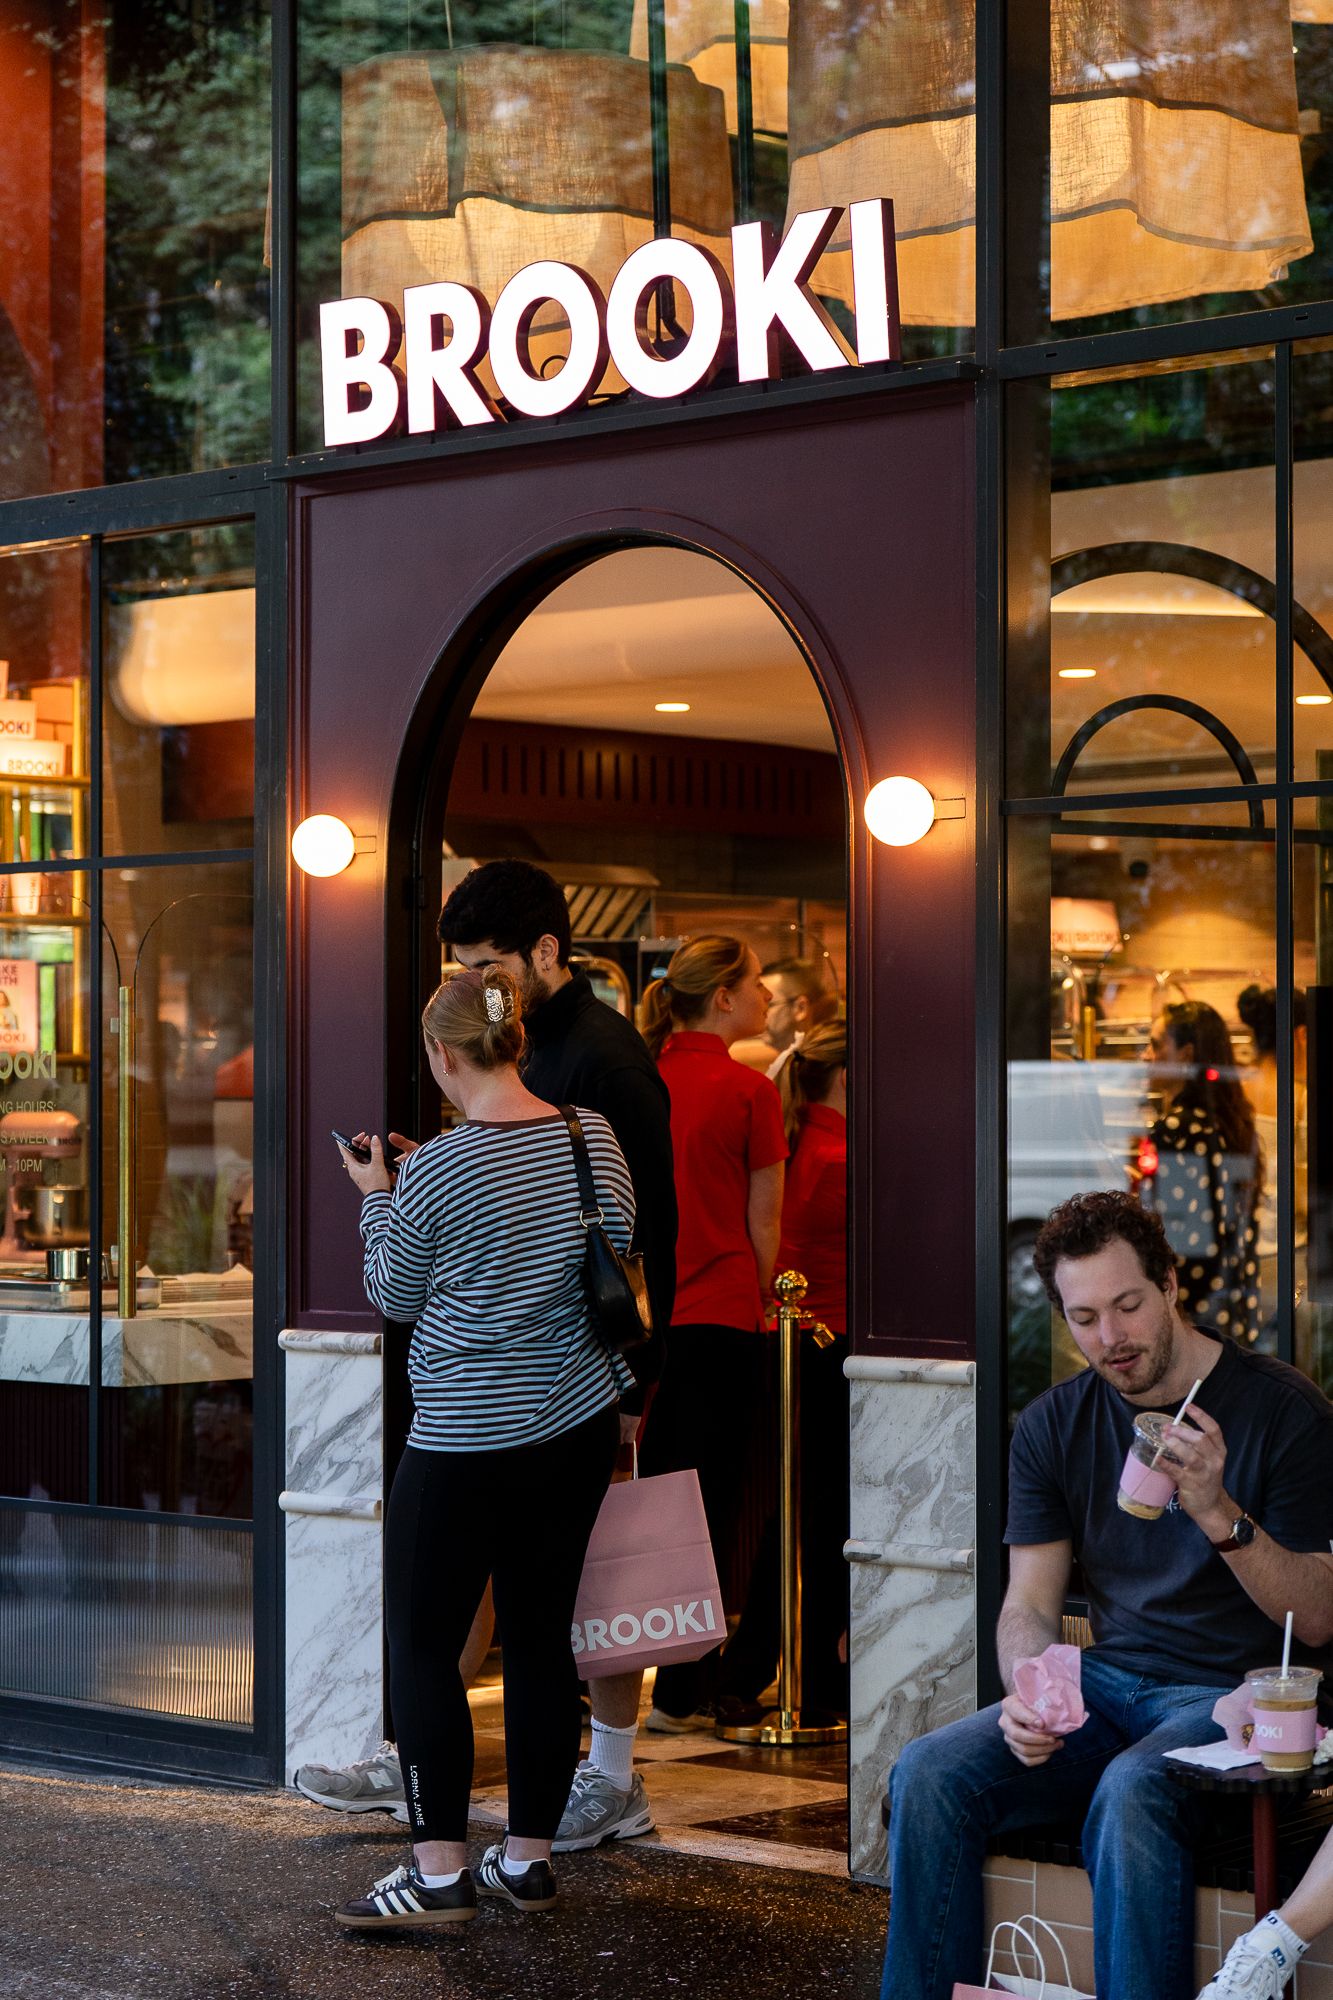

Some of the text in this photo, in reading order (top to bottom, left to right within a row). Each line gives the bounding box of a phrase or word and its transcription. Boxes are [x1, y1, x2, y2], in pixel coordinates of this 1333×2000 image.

[319, 198, 894, 447] BROOKI
[8, 759, 59, 775] BROOKI
[0, 965, 17, 975] KE
[16, 1101, 57, 1113] HOURS:
[19, 1131, 49, 1144] WEEK
[16, 1159, 42, 1172] 10PM
[571, 1599, 716, 1654] BROOKI
[410, 1765, 425, 1826] LORNA JANE
